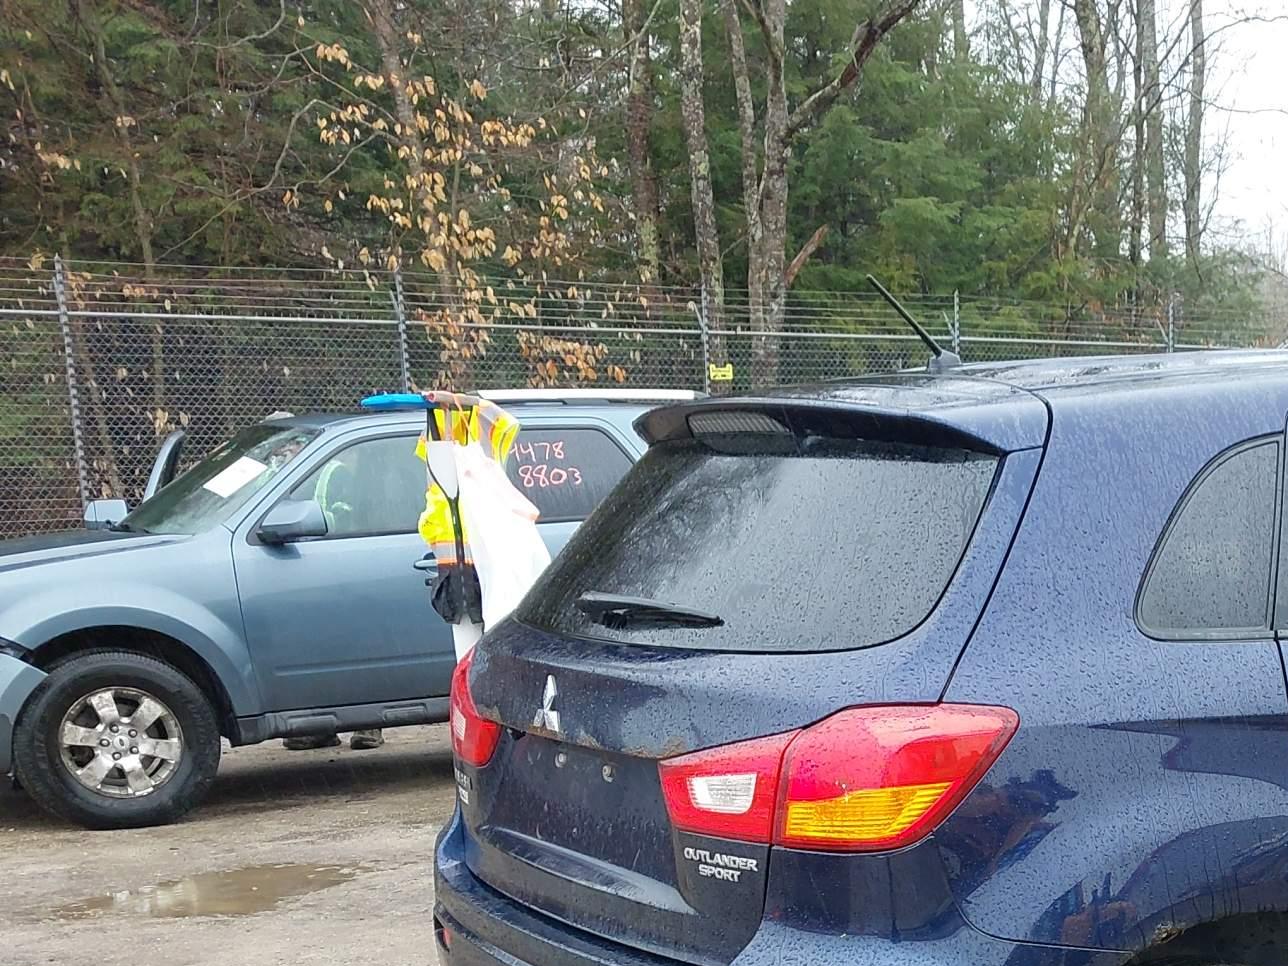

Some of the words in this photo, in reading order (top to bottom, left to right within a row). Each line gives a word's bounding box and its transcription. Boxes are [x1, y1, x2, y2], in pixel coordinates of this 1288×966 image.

[518, 464, 582, 488] 8803
[683, 847, 759, 872] OUTLANDER
[698, 863, 741, 882] SPORT
